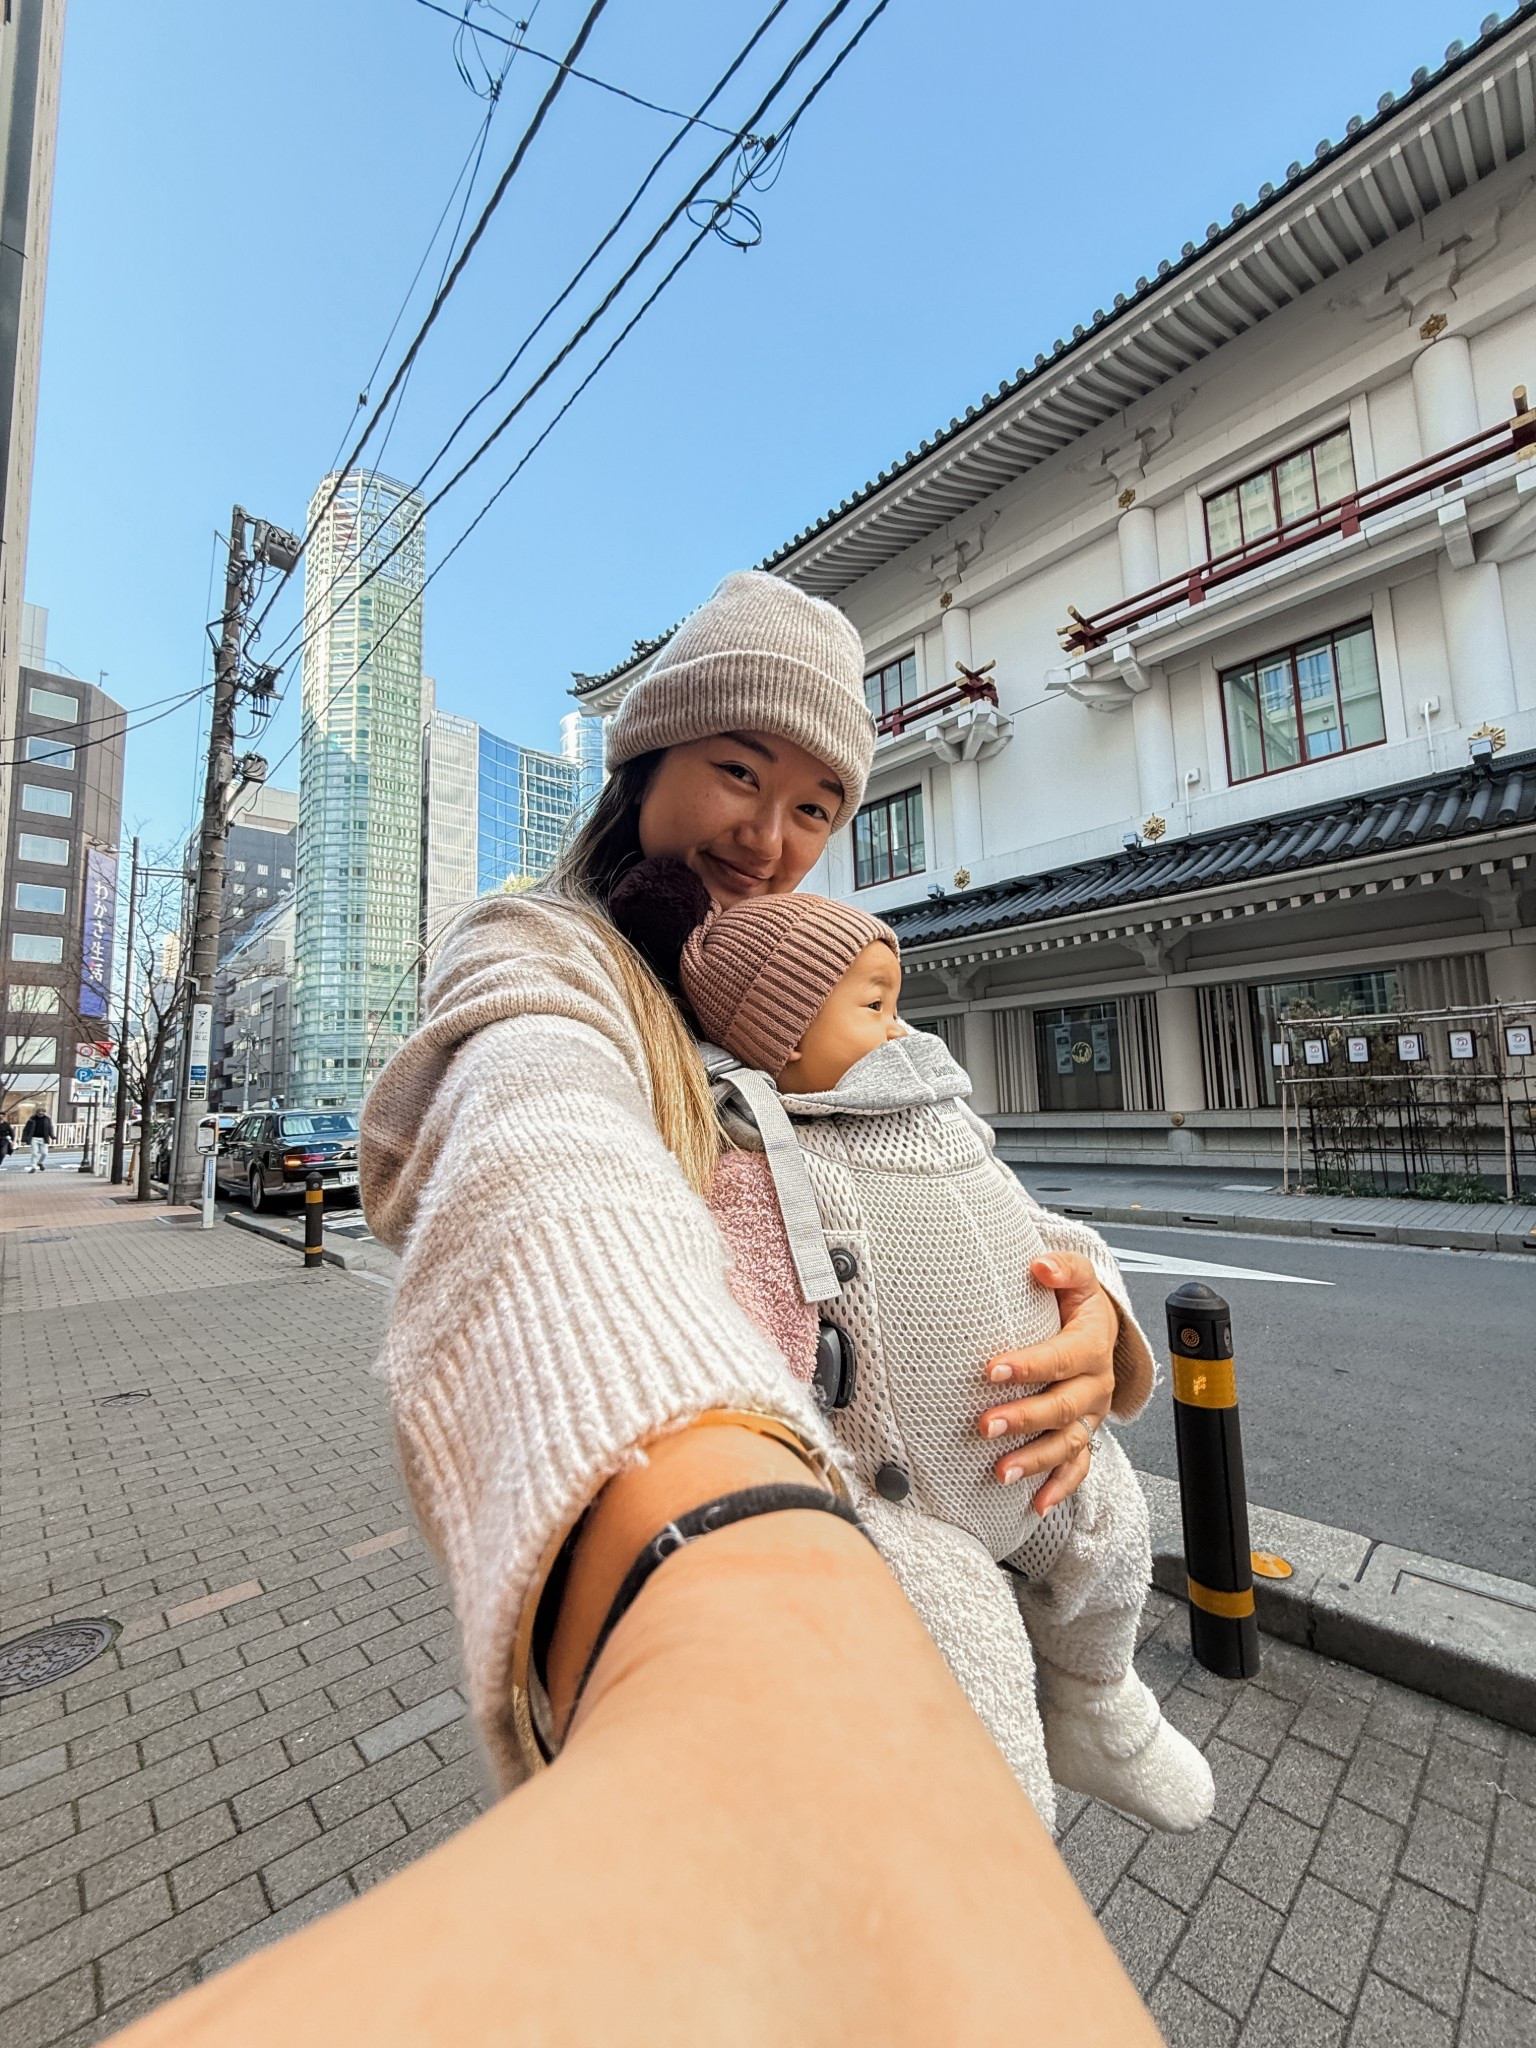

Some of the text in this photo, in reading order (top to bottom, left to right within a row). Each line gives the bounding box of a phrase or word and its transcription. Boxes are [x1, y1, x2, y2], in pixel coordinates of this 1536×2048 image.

[89, 881, 109, 983] わかさ生活
[80, 1070, 88, 1081] P
